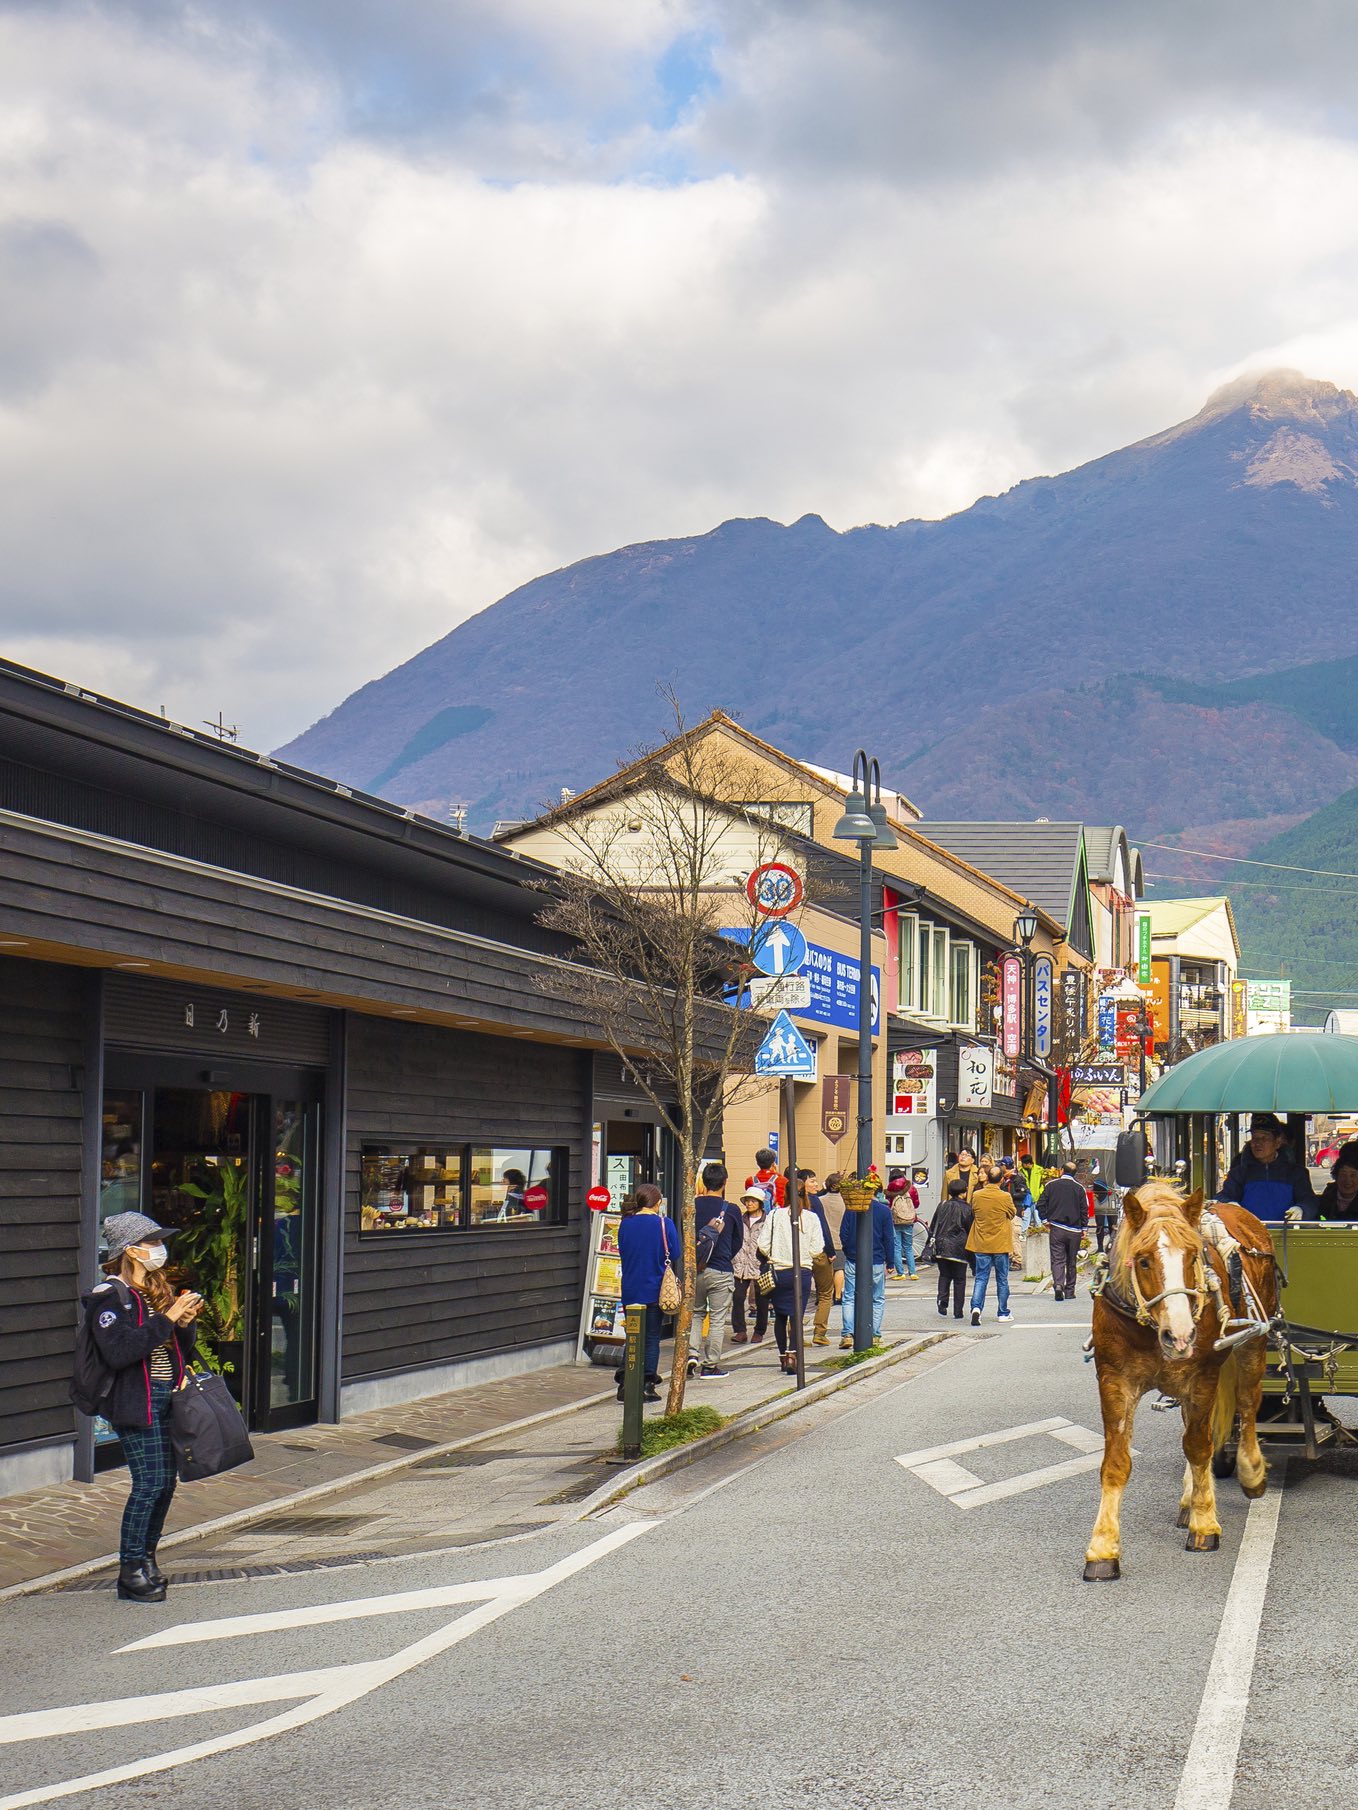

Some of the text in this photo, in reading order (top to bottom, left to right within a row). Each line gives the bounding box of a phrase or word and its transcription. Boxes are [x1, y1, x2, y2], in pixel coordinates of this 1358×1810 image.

[760, 878, 791, 902] 30
[1036, 964, 1050, 1052] バスセンター
[613, 1158, 625, 1169] ス
